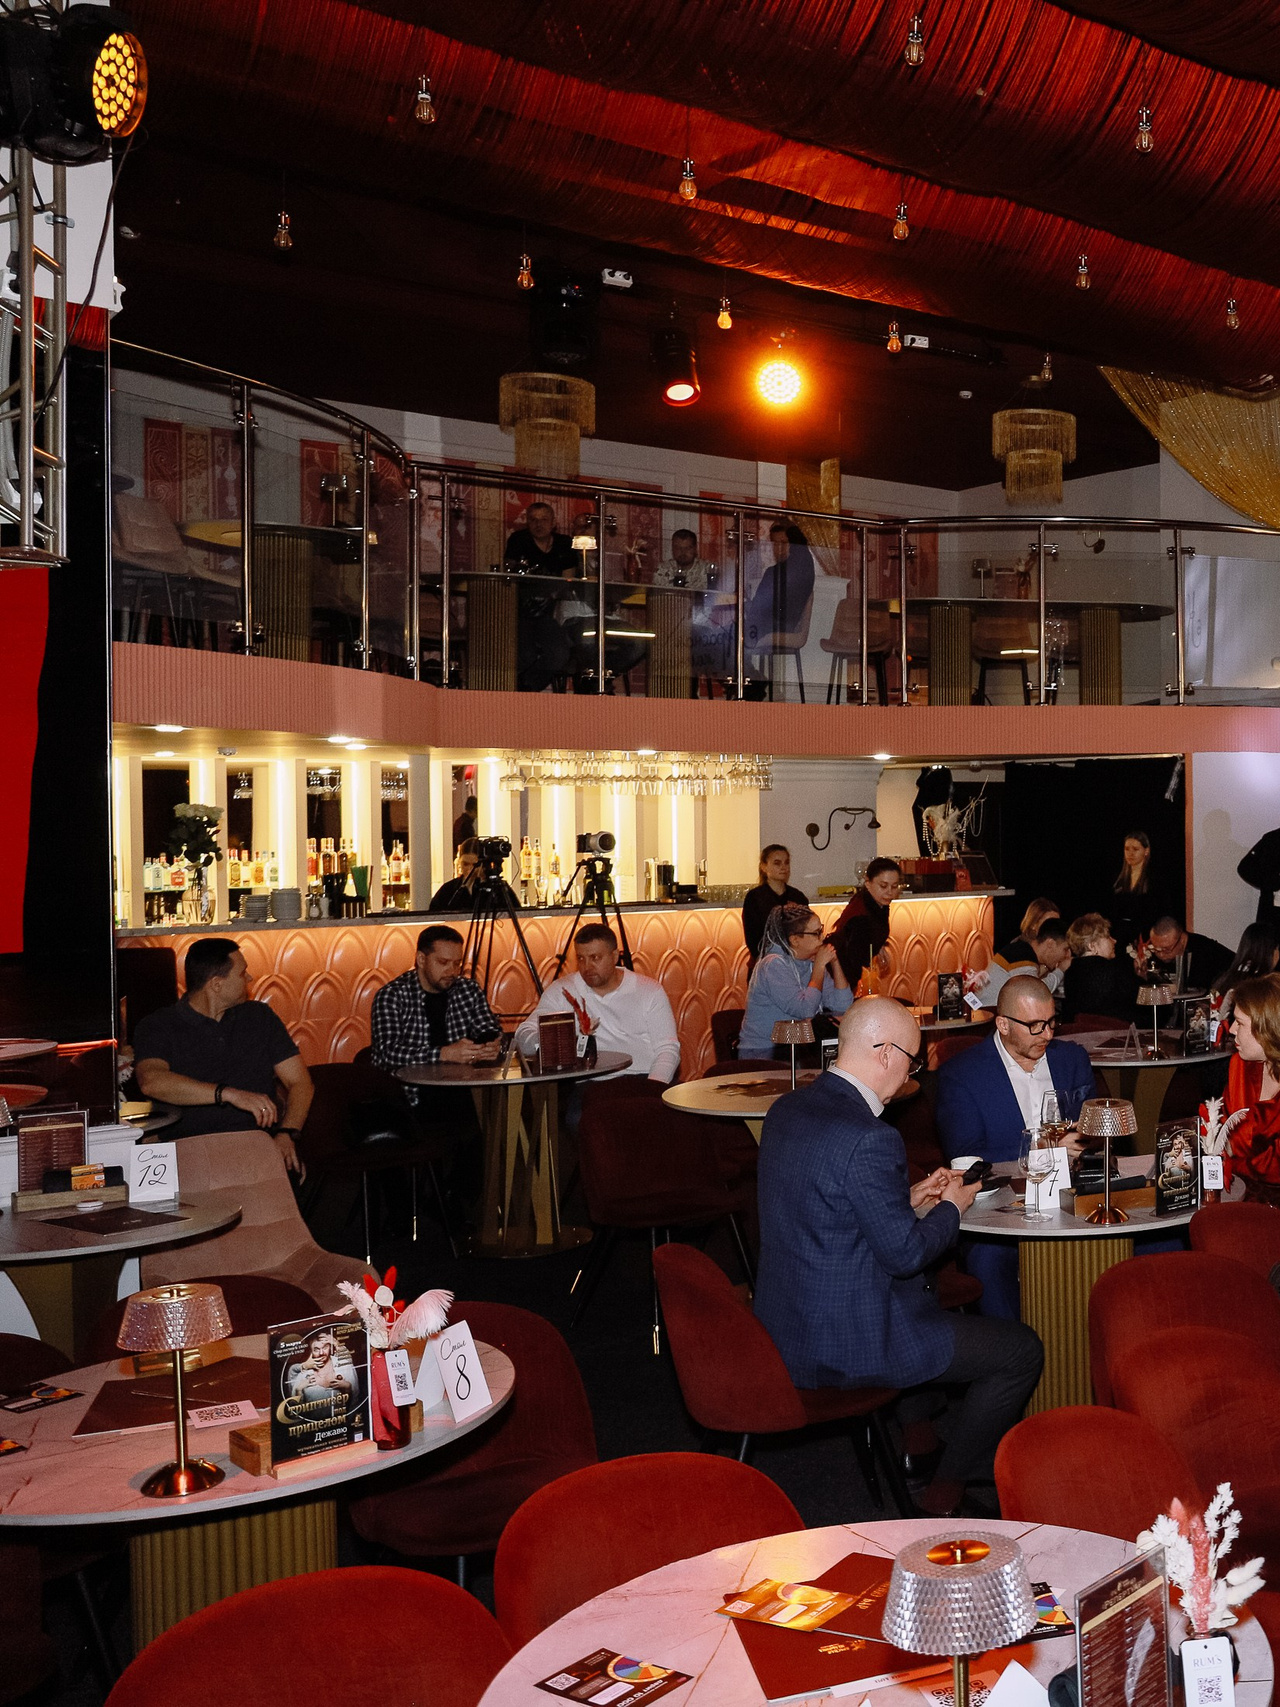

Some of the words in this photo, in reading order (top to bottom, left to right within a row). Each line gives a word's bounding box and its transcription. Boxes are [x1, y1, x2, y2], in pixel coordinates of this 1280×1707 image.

[138, 1163, 168, 1188] 12
[1049, 1168, 1060, 1197] 7
[456, 1353, 471, 1401] 8
[288, 1414, 347, 1438] прицелом
[314, 1426, 348, 1443] Дежавю
